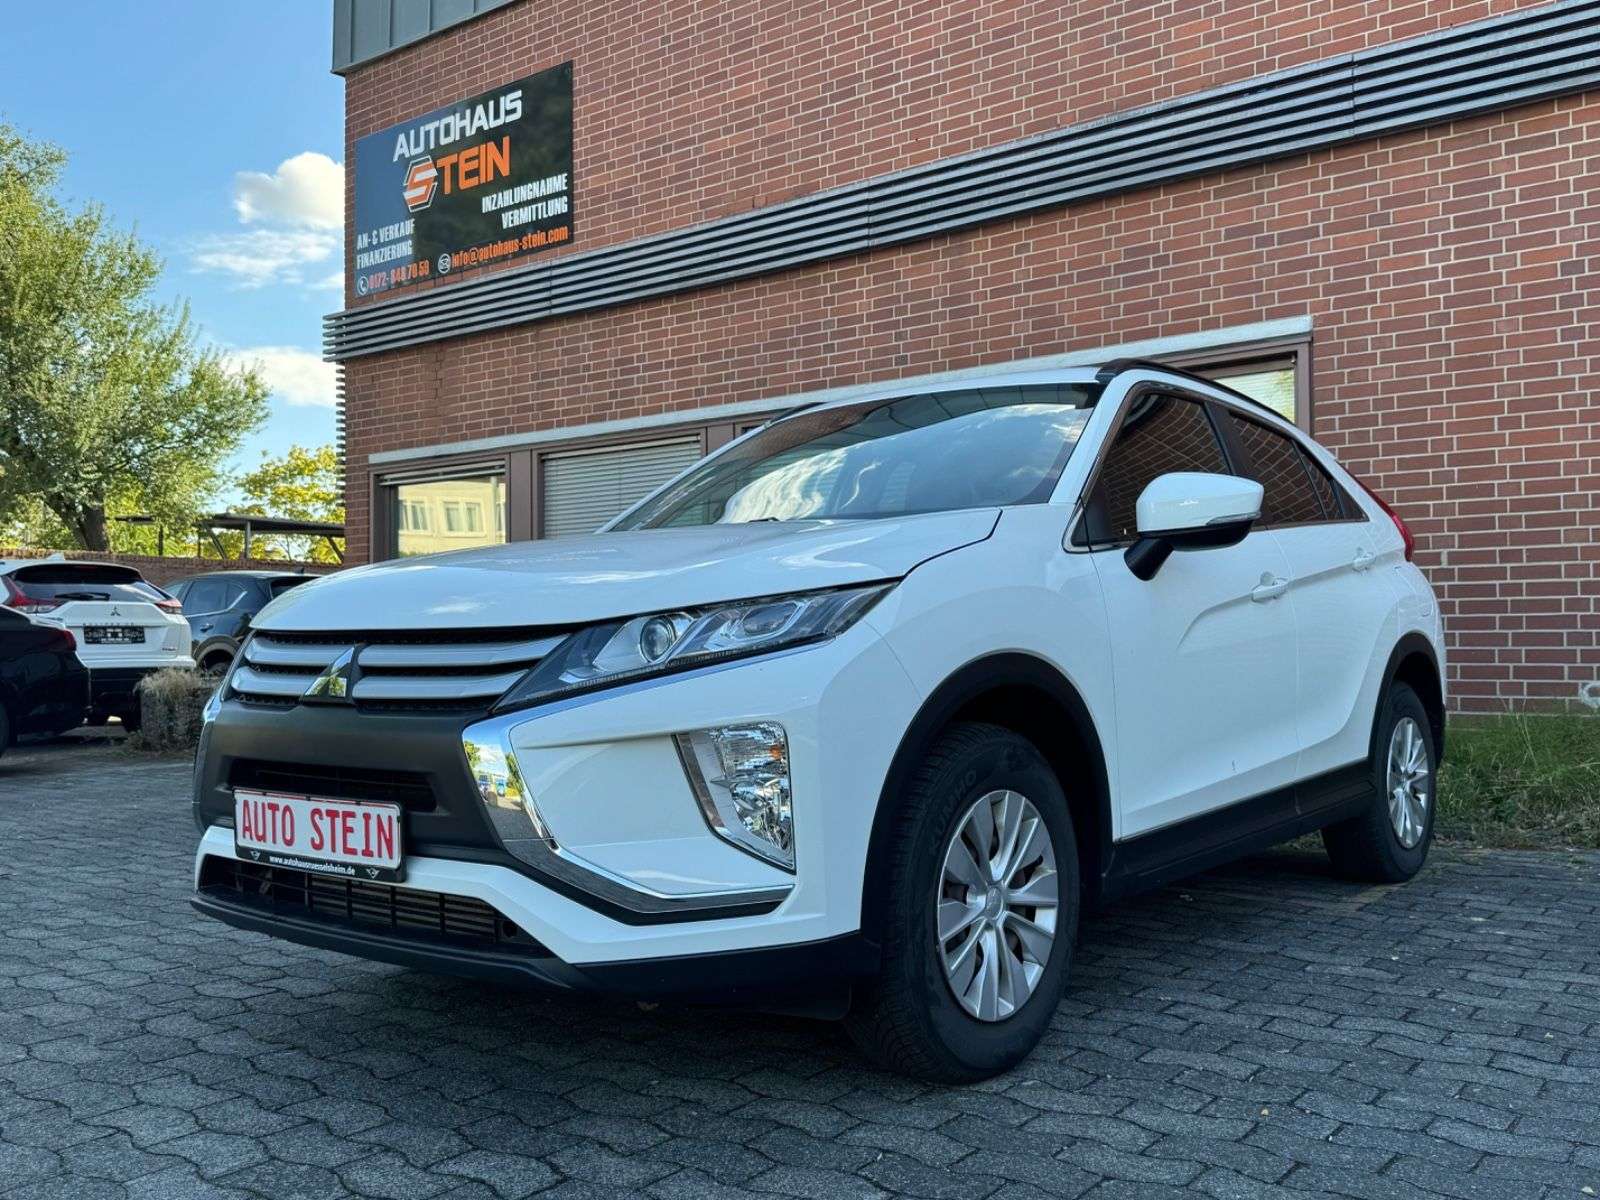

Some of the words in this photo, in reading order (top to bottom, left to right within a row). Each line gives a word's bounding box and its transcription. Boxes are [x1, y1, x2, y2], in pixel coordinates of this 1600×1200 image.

[393, 90, 523, 162] AUTOHAUS
[481, 172, 569, 213] INZAHLUNGNAHME
[501, 195, 569, 230] VERMITTLUNG
[379, 217, 416, 243] VERKAUF
[451, 225, 569, 268] info@autohaus-stein.com
[356, 239, 414, 270] FINANZIERUNG
[242, 799, 296, 847] AUTO
[310, 807, 394, 860] STEIN
